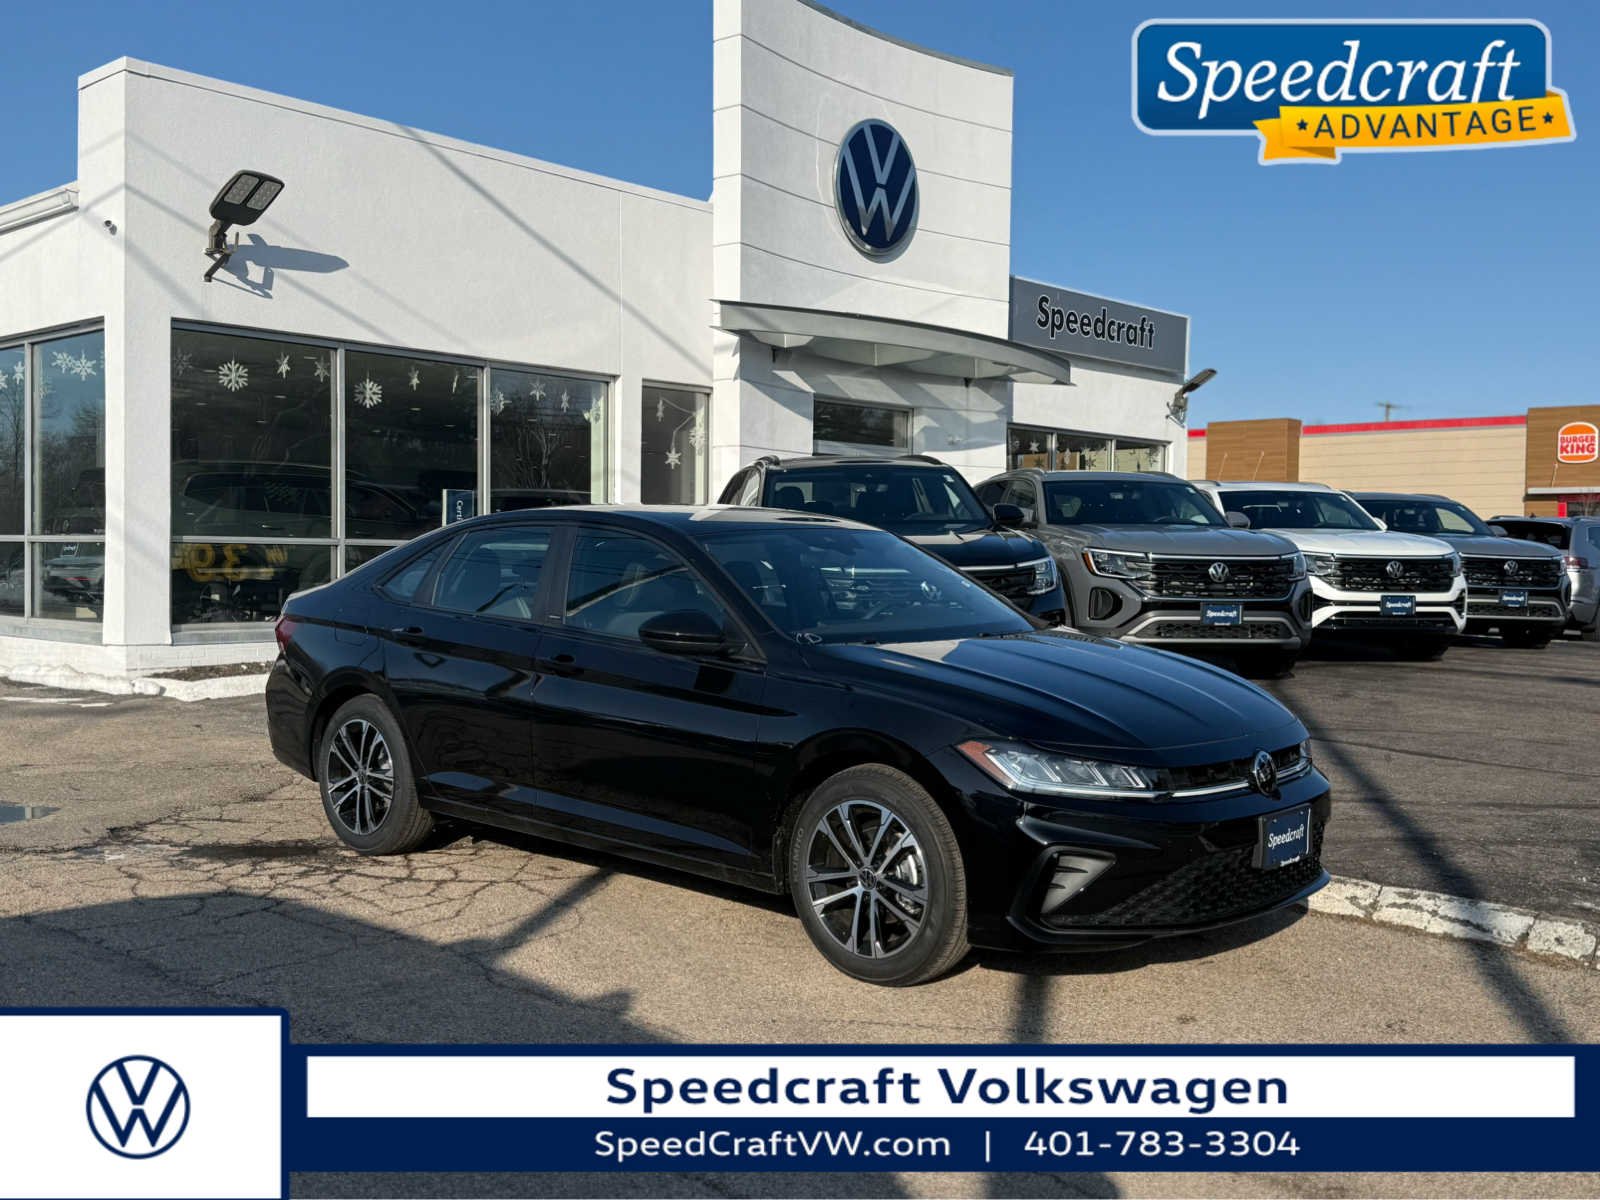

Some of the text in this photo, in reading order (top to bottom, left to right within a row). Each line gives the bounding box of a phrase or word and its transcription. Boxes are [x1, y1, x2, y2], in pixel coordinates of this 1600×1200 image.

[1036, 294, 1155, 349] Speedcraft
[1560, 435, 1595, 444] BURGER
[1560, 443, 1595, 455] KING
[1267, 823, 1305, 850] Speedcraft
